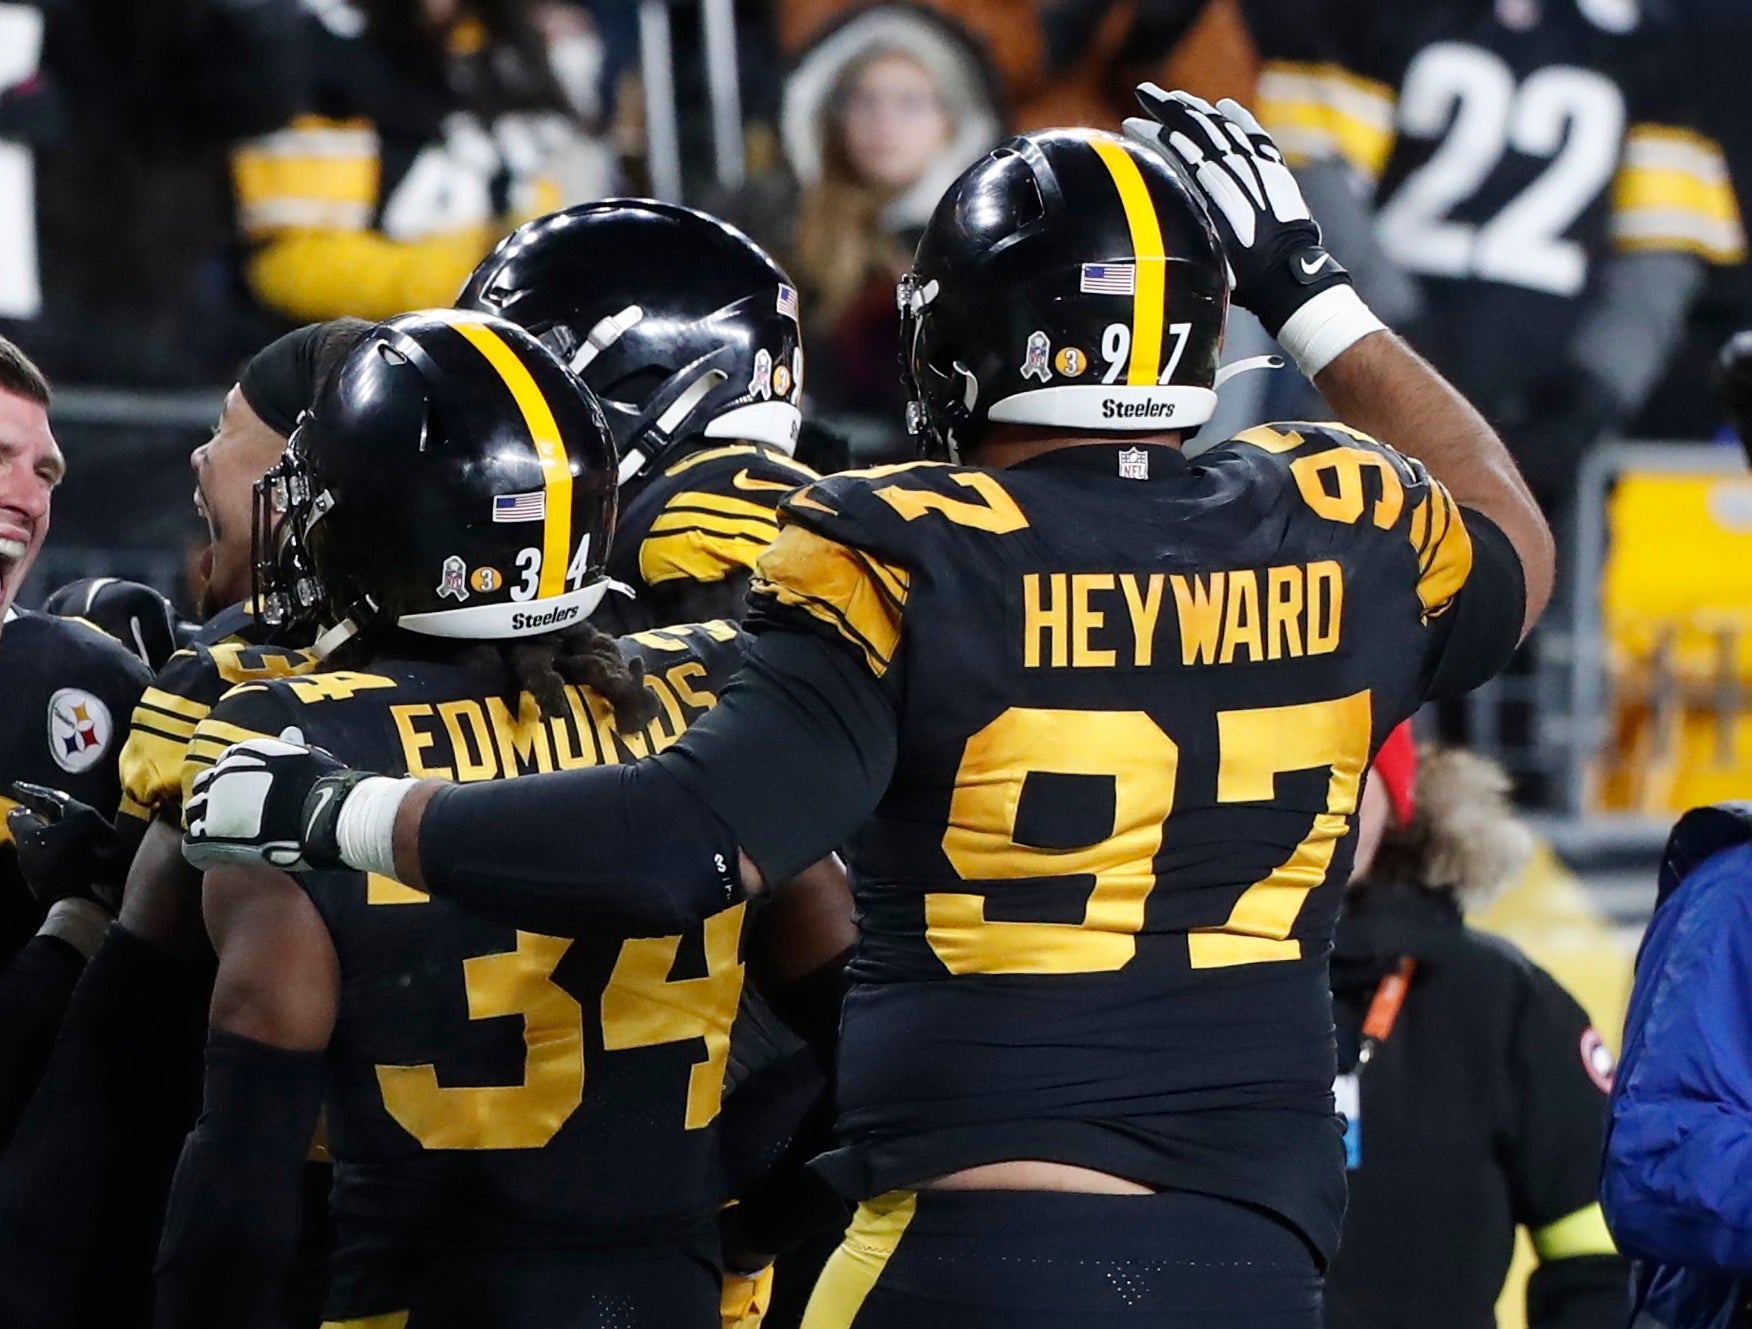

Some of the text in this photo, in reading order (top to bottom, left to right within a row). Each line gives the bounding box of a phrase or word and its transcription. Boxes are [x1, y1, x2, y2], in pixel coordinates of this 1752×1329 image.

[1374, 39, 1627, 297] 22
[1065, 350, 1078, 375] 3
[1101, 322, 1192, 385] 97
[1102, 398, 1176, 419] Steelers
[1123, 464, 1147, 480] NFL
[480, 569, 494, 592] 3
[510, 532, 591, 602] 34
[512, 605, 580, 630] Steelers
[1022, 560, 1344, 669] HEYWARD
[925, 688, 1373, 975] 97
[367, 872, 747, 1150] 34
